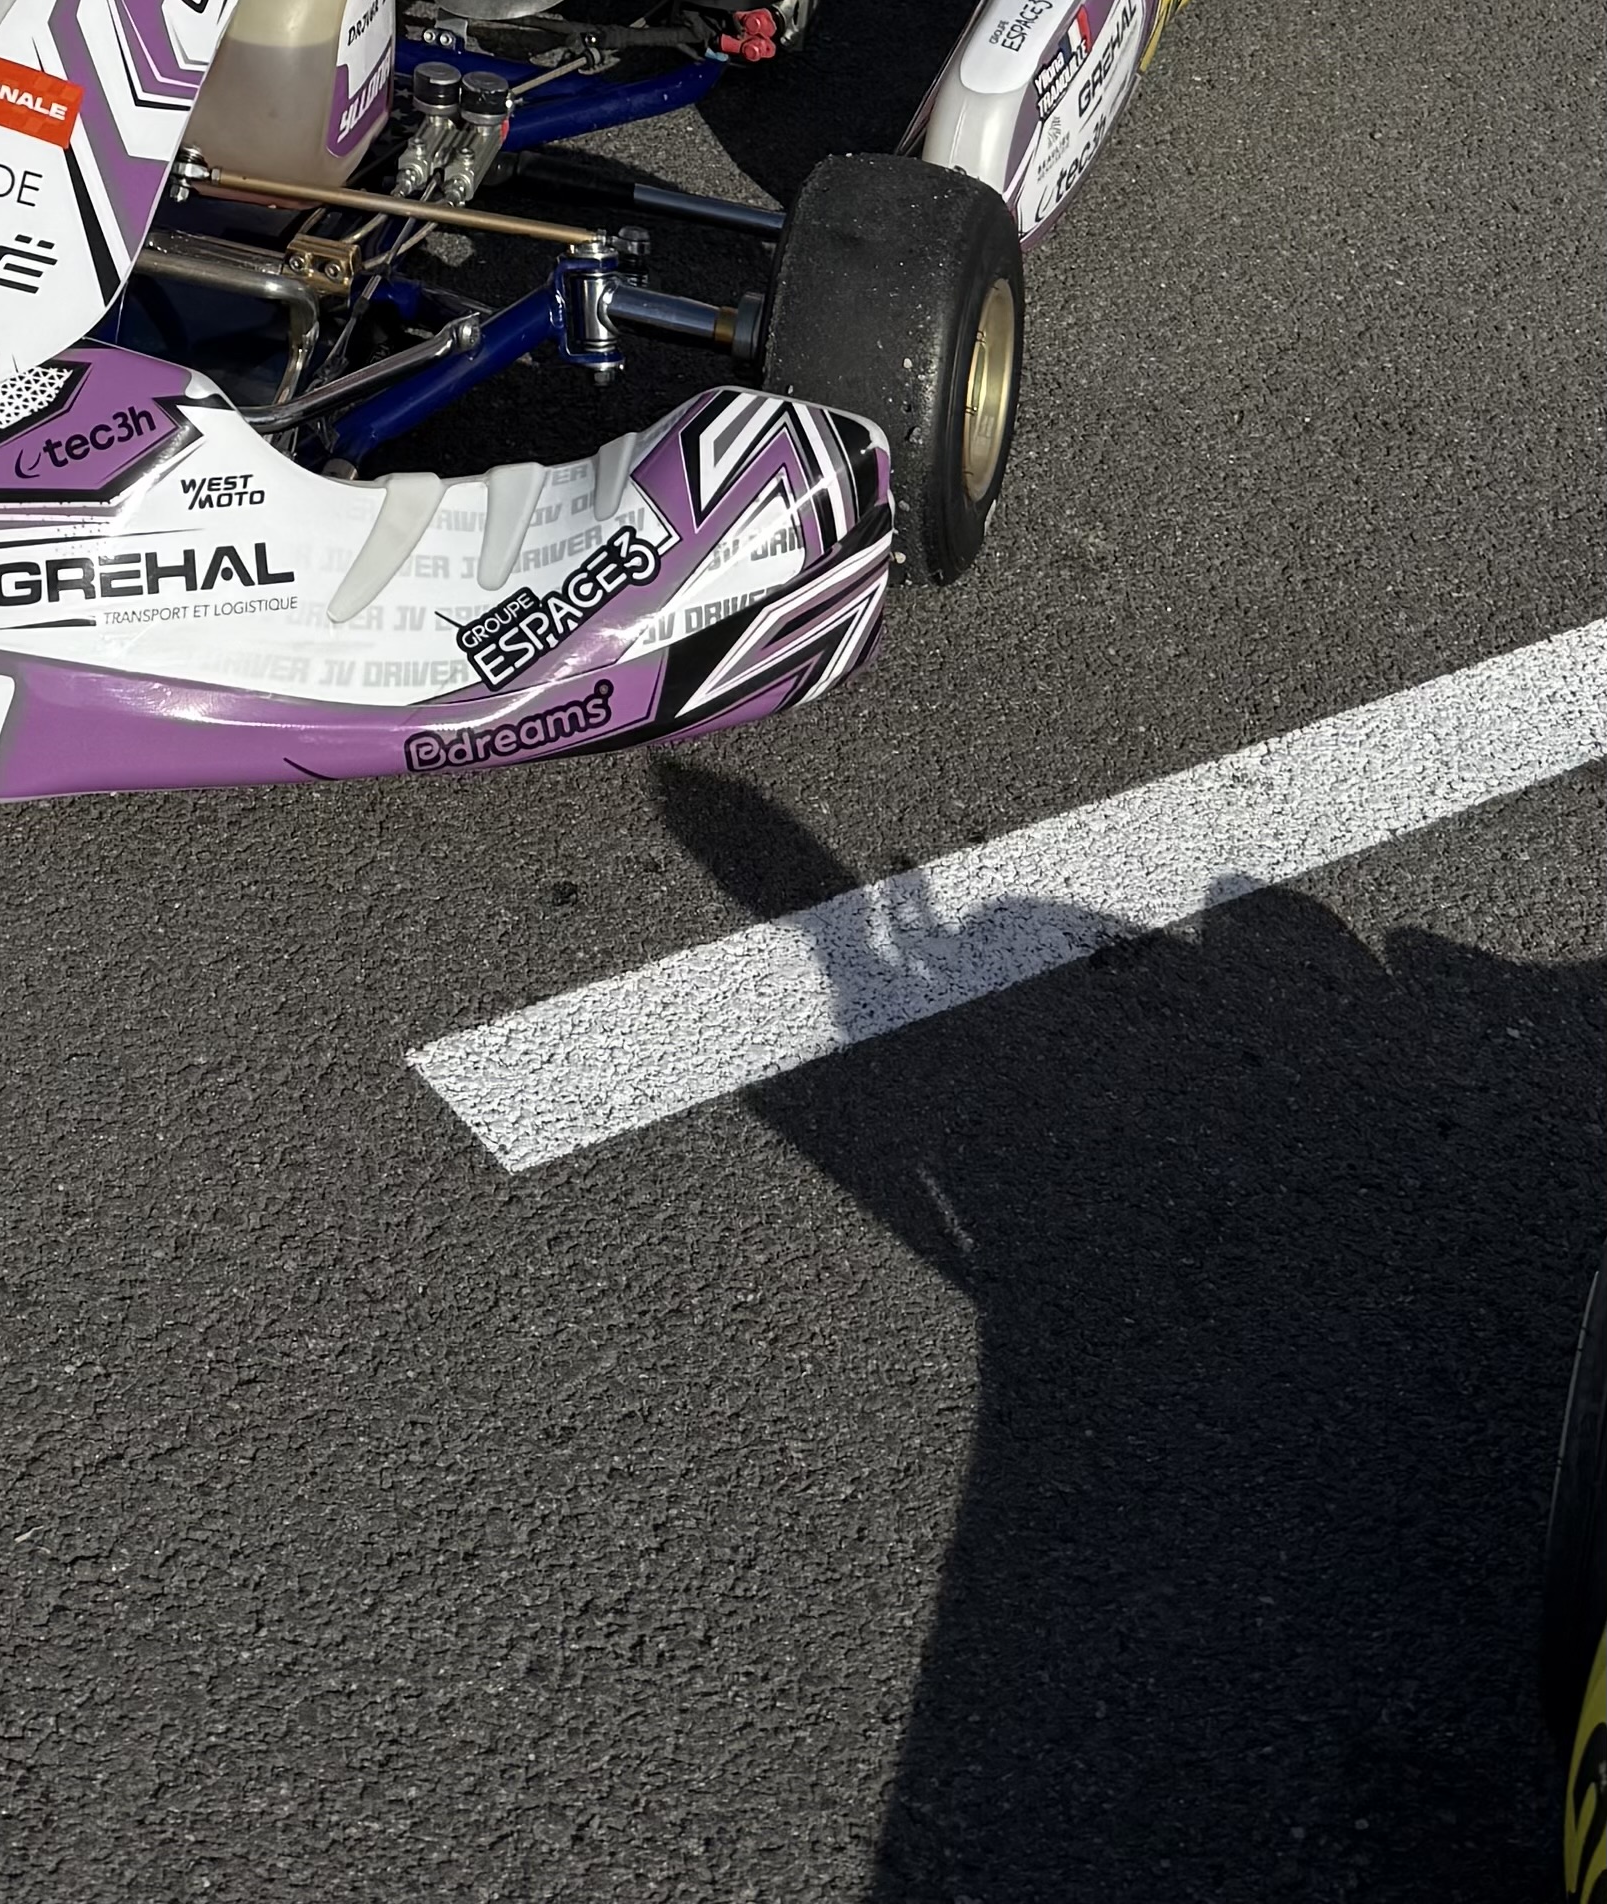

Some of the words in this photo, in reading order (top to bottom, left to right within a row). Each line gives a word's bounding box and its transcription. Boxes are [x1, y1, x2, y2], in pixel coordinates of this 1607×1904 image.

[42, 403, 158, 471] tec3h
[179, 473, 256, 496] WEST
[194, 487, 267, 511] MOTO
[103, 603, 192, 625] TRANSPORT
[193, 603, 212, 619] ET
[214, 596, 298, 618] LOGISTIQUE
[461, 592, 535, 649] GROUPE
